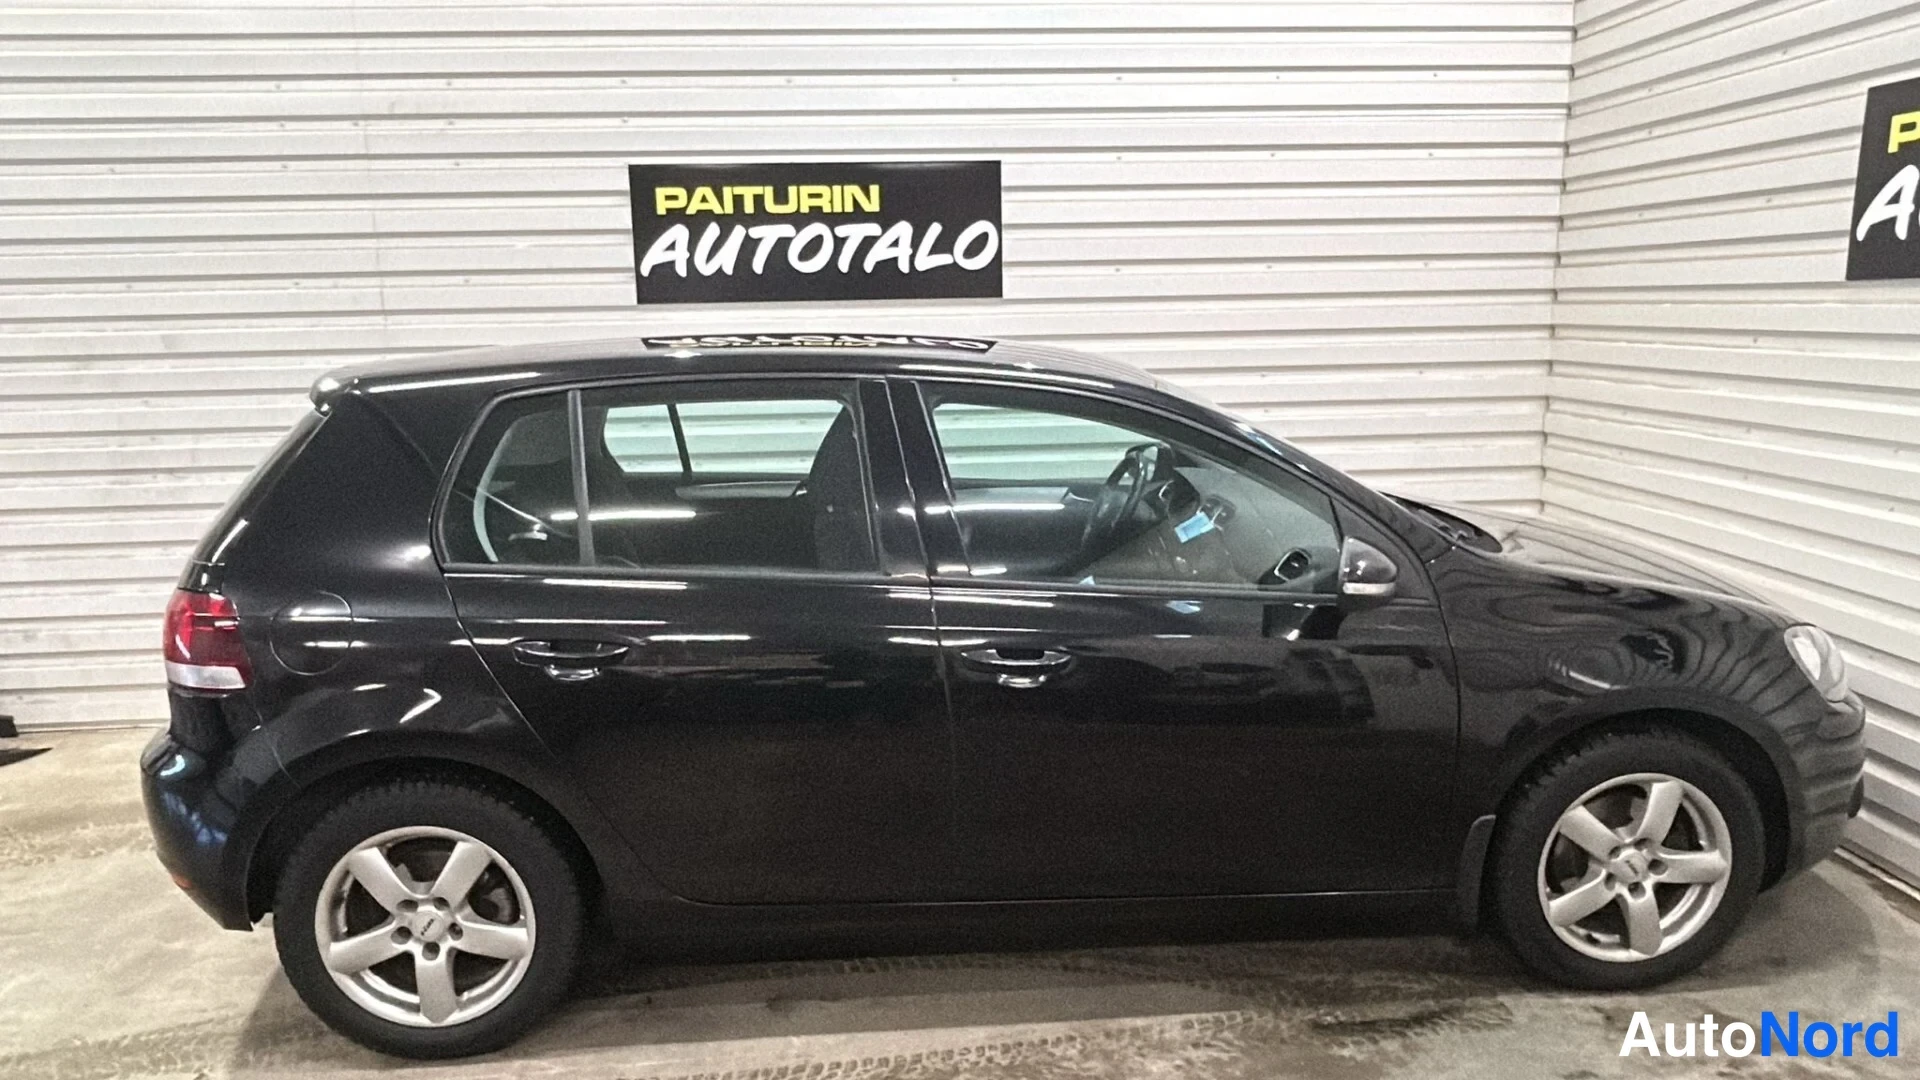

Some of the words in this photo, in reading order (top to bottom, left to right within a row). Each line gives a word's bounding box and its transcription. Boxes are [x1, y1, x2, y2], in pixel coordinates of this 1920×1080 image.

[655, 184, 881, 216] PAITURIN
[1856, 164, 1920, 242] A
[640, 219, 999, 278] AUTOTALO
